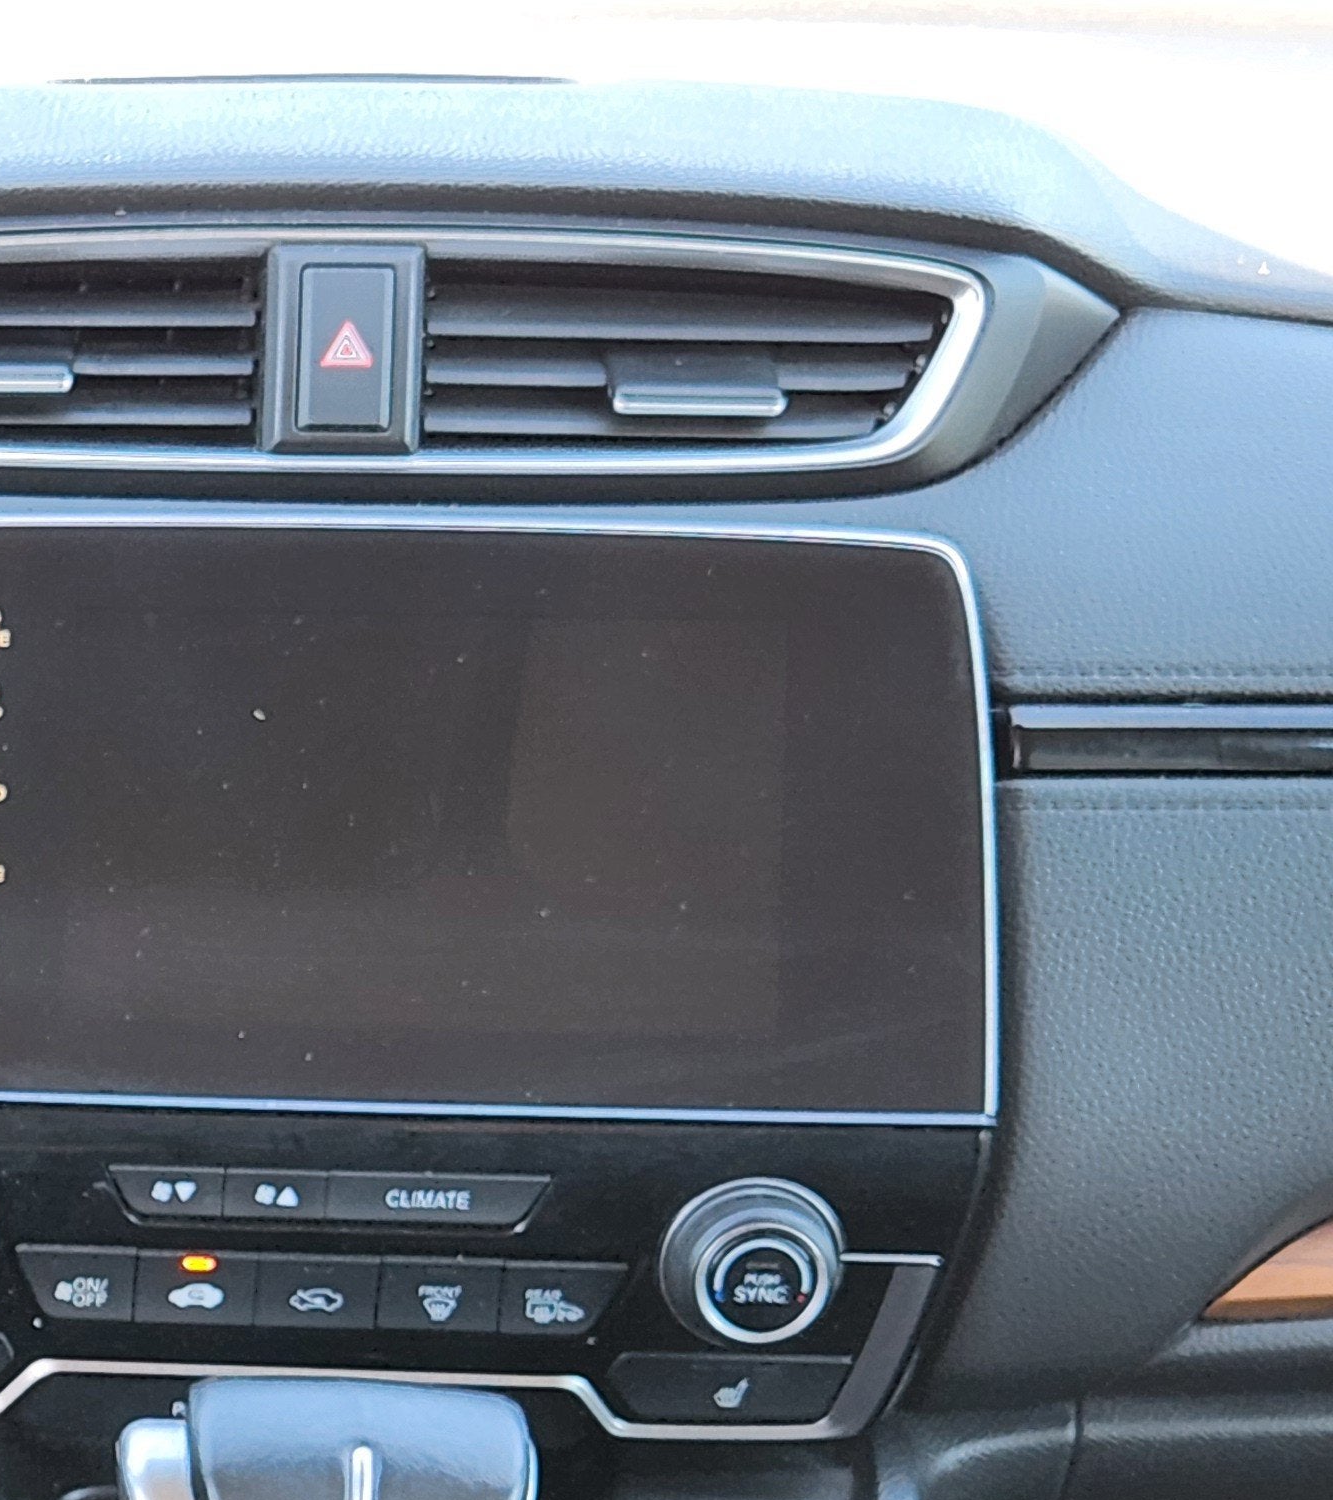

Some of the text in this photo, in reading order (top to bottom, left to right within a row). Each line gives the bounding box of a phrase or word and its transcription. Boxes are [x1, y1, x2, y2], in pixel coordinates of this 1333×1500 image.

[385, 1188, 471, 1211] CLIMATE
[72, 1290, 108, 1308] OFF
[733, 1284, 790, 1304] SYNC
